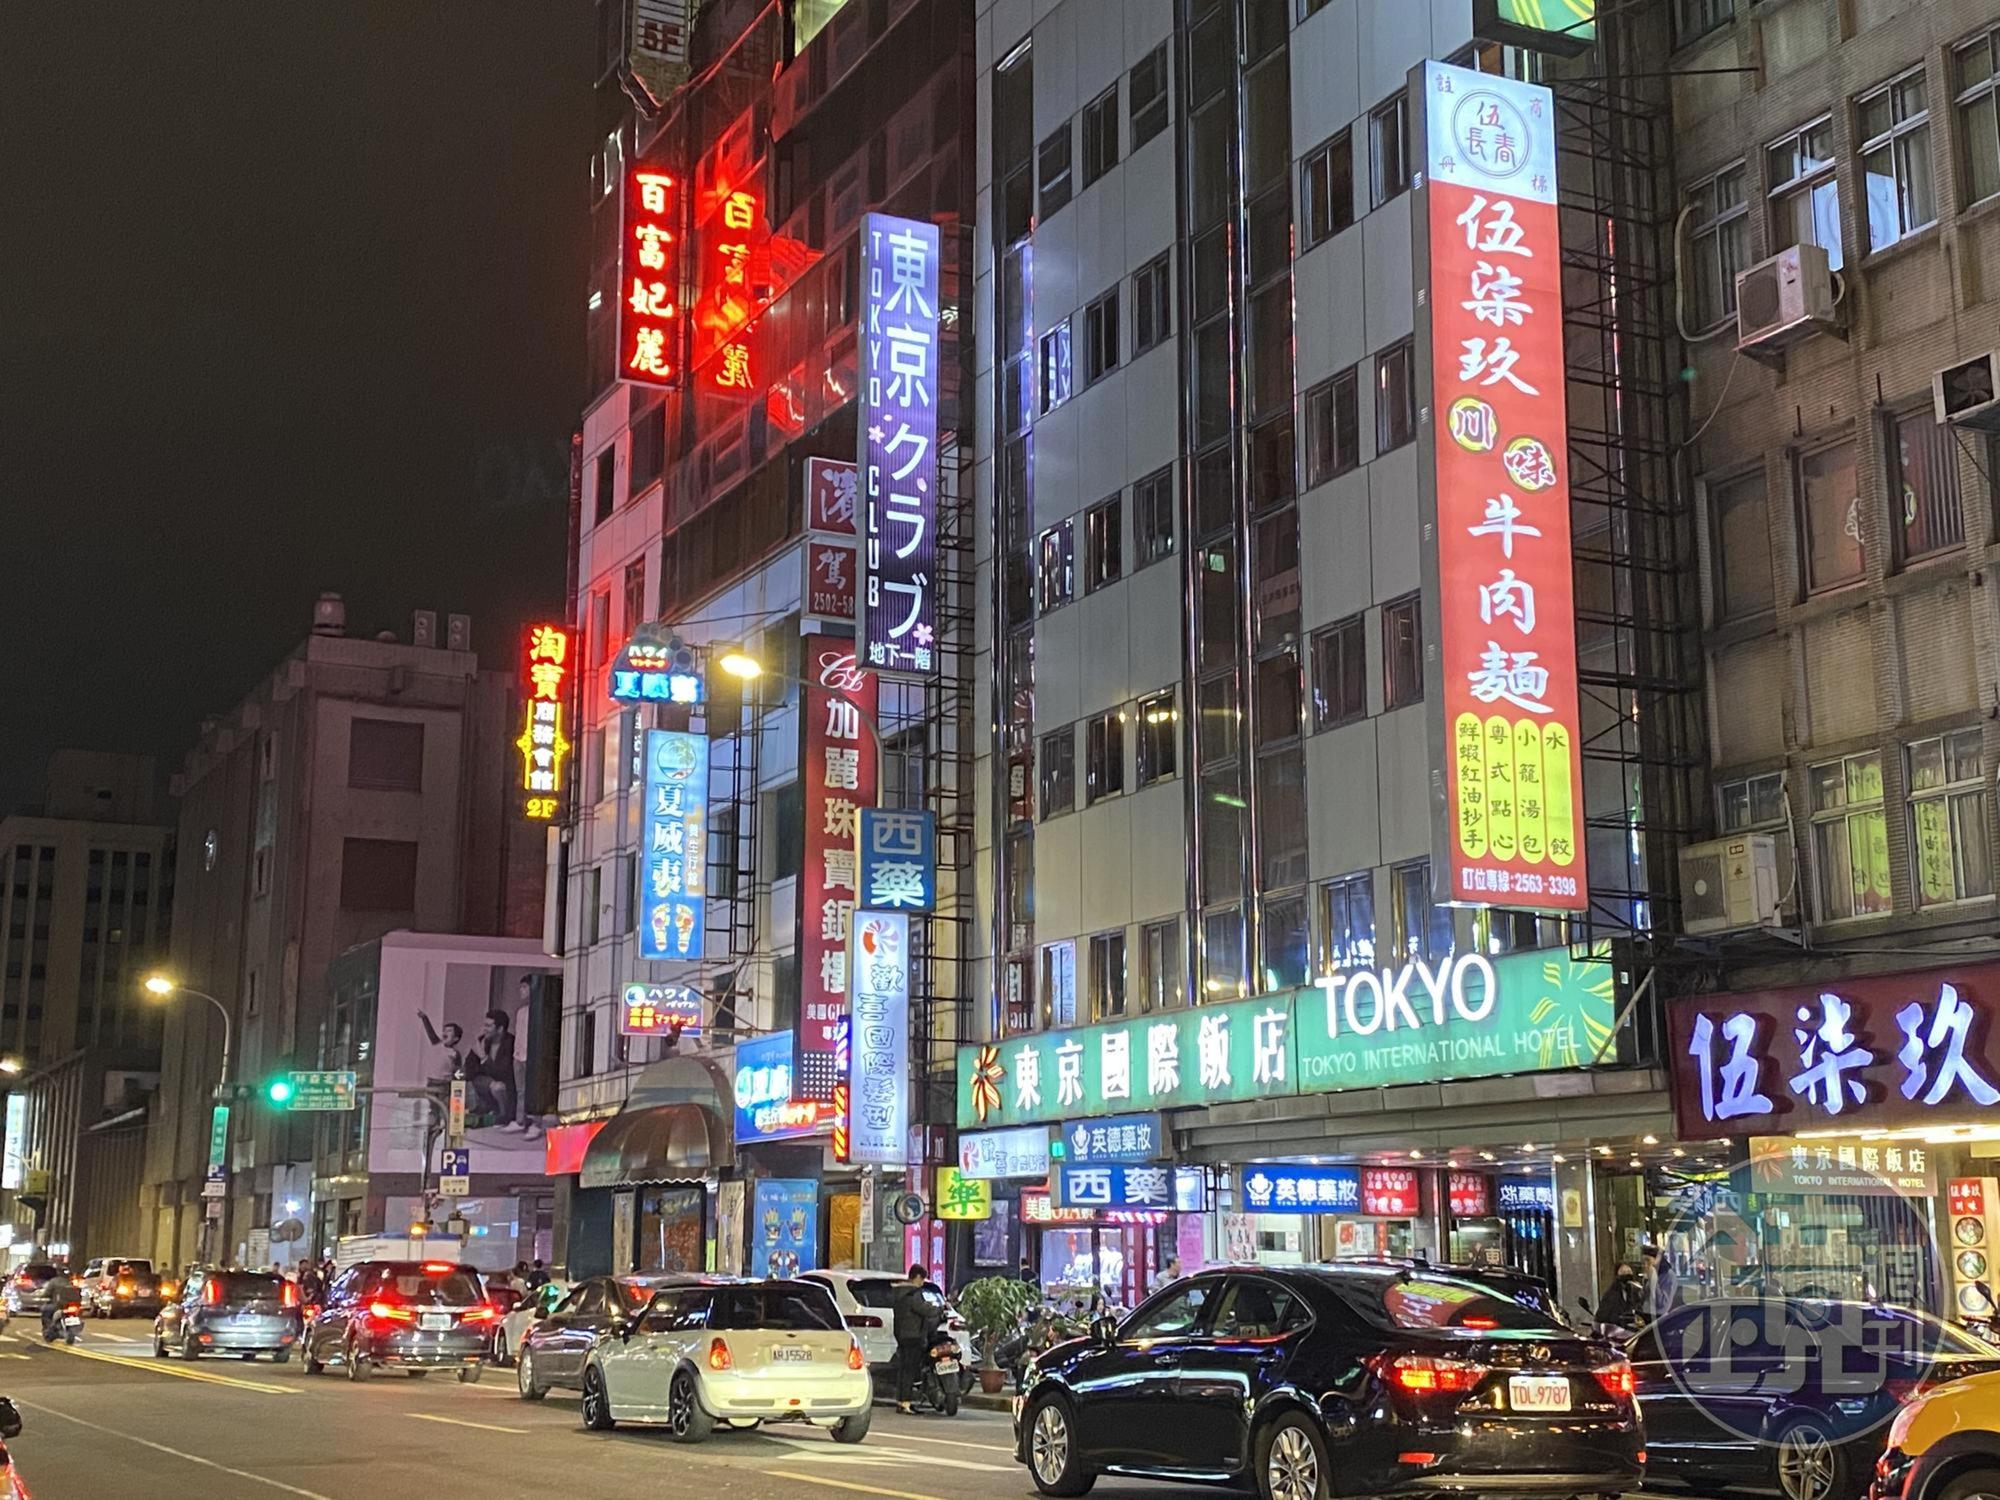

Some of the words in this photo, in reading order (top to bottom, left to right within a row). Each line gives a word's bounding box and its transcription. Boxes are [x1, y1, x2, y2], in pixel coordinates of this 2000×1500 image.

[644, 21, 679, 52] 5F
[628, 173, 672, 377] 百富妃麗
[869, 230, 882, 408] TOKYO
[867, 464, 881, 608] CLUB
[1466, 492, 1555, 714] 牛肉麵
[869, 640, 932, 671] 地下一階
[526, 798, 557, 818] 2F
[1459, 722, 1484, 849] 鮮蝦紅油抄手
[1517, 728, 1541, 854] 小籠湯包
[1545, 732, 1571, 857] 水餃
[652, 783, 685, 898] 夏威夷
[870, 812, 925, 907] 西藥
[1315, 953, 1496, 1039] TOKYO
[1014, 1007, 1286, 1111] 東京國際飯店
[1302, 1051, 1356, 1077] TOKYO
[1364, 1034, 1506, 1071] INTERNATIONAL
[1514, 1026, 1582, 1055] HOTEL
[1688, 982, 2000, 1122] 伍柒玖
[442, 1151, 456, 1170] P
[1091, 1123, 1151, 1153] 英德藥妝
[1790, 1144, 1926, 1173] 東京國際飯店
[1793, 1174, 1823, 1186] TOKYO
[1828, 1176, 1893, 1188] INTERNATIONAL
[1898, 1177, 1926, 1188] HOTEL
[1066, 1167, 1169, 1205] 西藥
[1275, 1178, 1358, 1202] 英德藥妝
